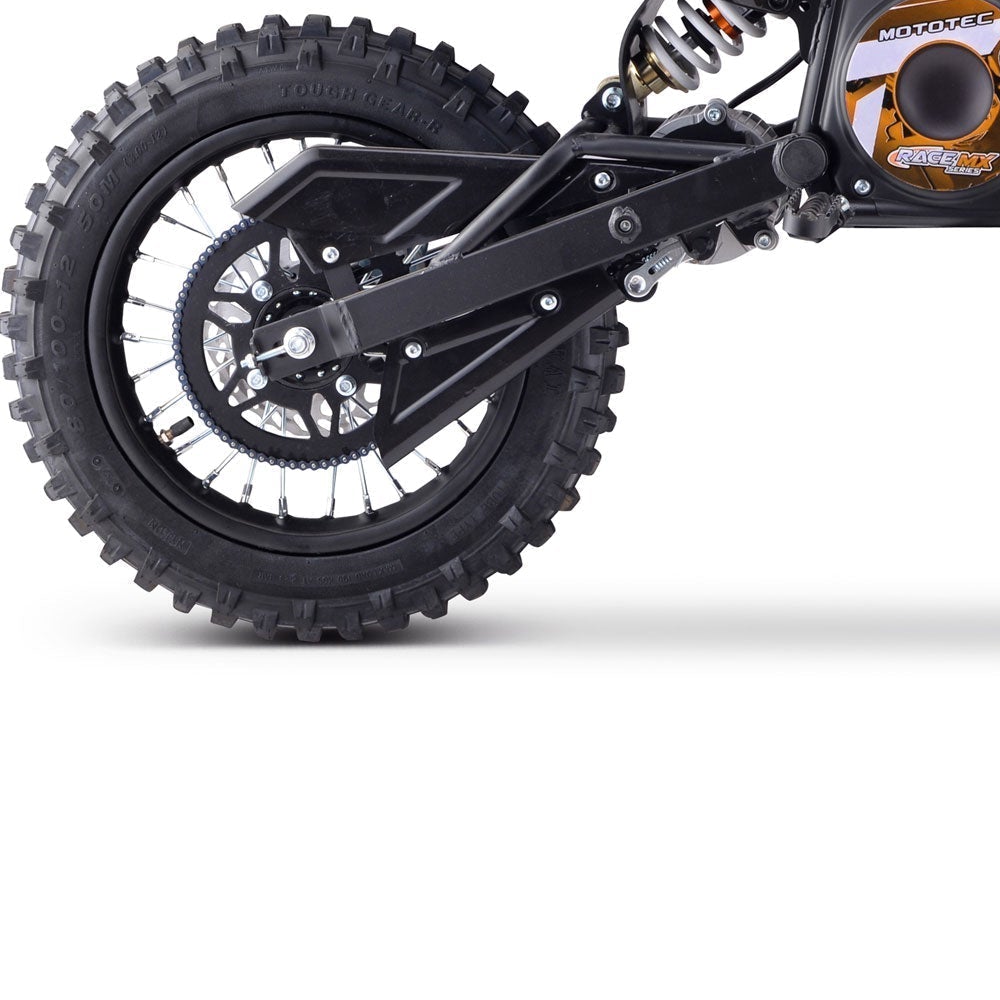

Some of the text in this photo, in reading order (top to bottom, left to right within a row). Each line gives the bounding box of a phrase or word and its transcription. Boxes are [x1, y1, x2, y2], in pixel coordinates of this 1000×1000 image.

[878, 12, 994, 42] MOTOTEC
[278, 82, 445, 136] TOUGH GEAR-R
[895, 149, 998, 168] RACE MX
[74, 166, 123, 233] 50M
